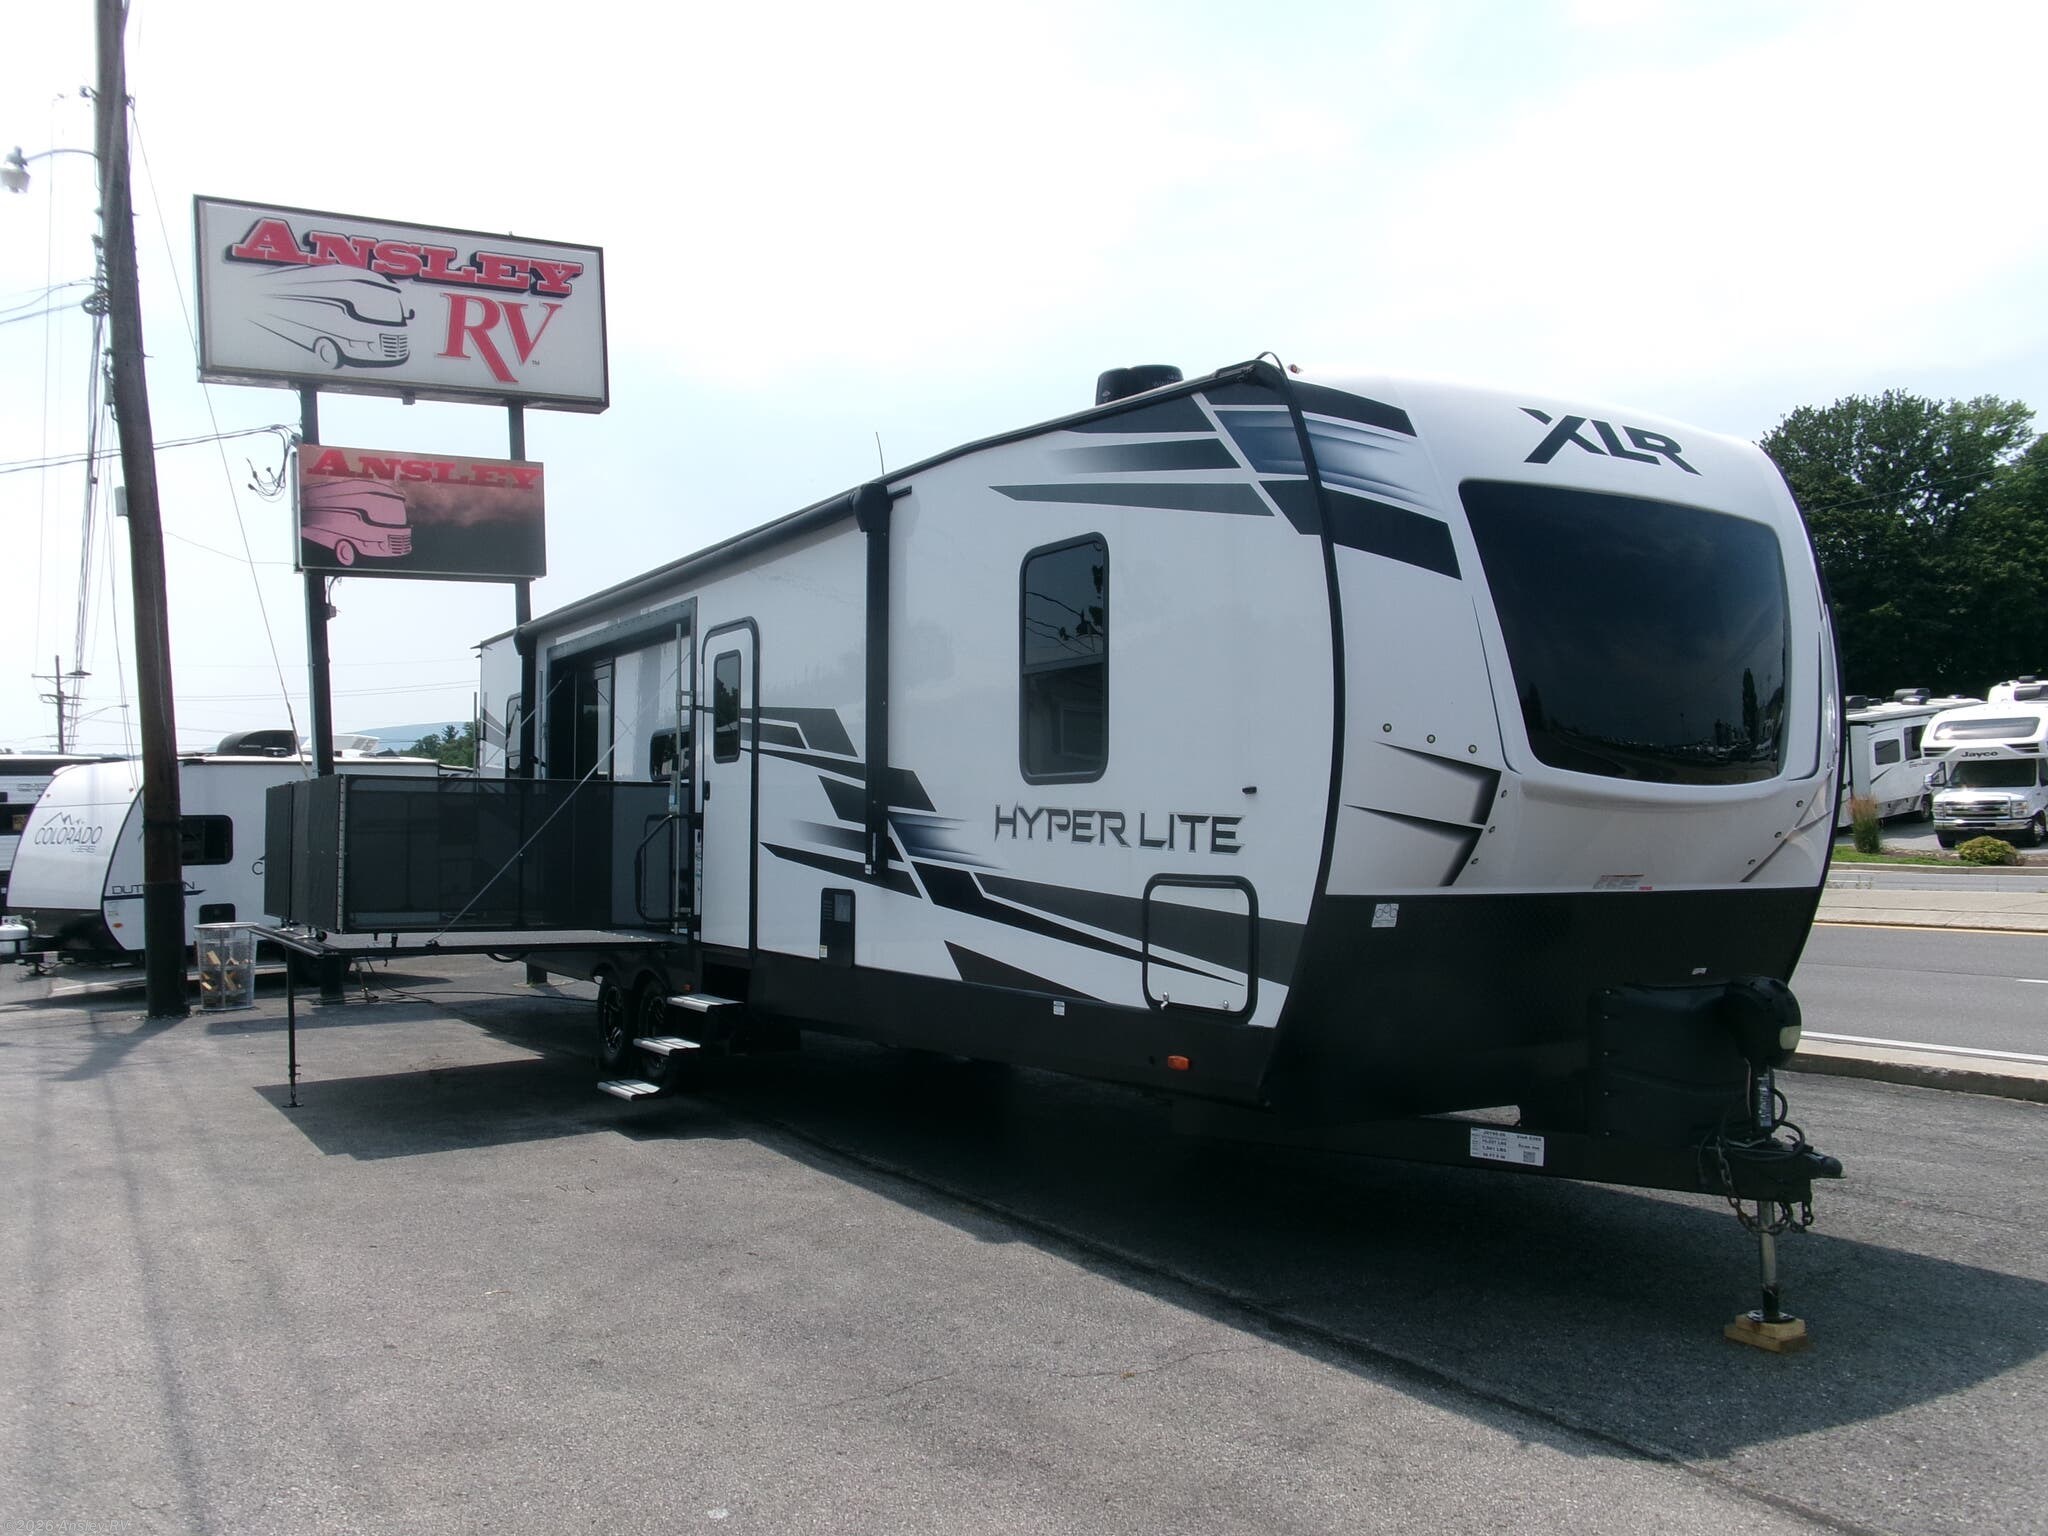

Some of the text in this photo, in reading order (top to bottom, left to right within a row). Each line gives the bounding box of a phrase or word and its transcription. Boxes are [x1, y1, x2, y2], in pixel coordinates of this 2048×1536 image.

[226, 217, 584, 298] ANSLEY
[435, 292, 563, 384] RV
[307, 449, 543, 490] ANSLEY
[1517, 406, 1703, 477] XLR
[35, 825, 103, 845] COLORADO
